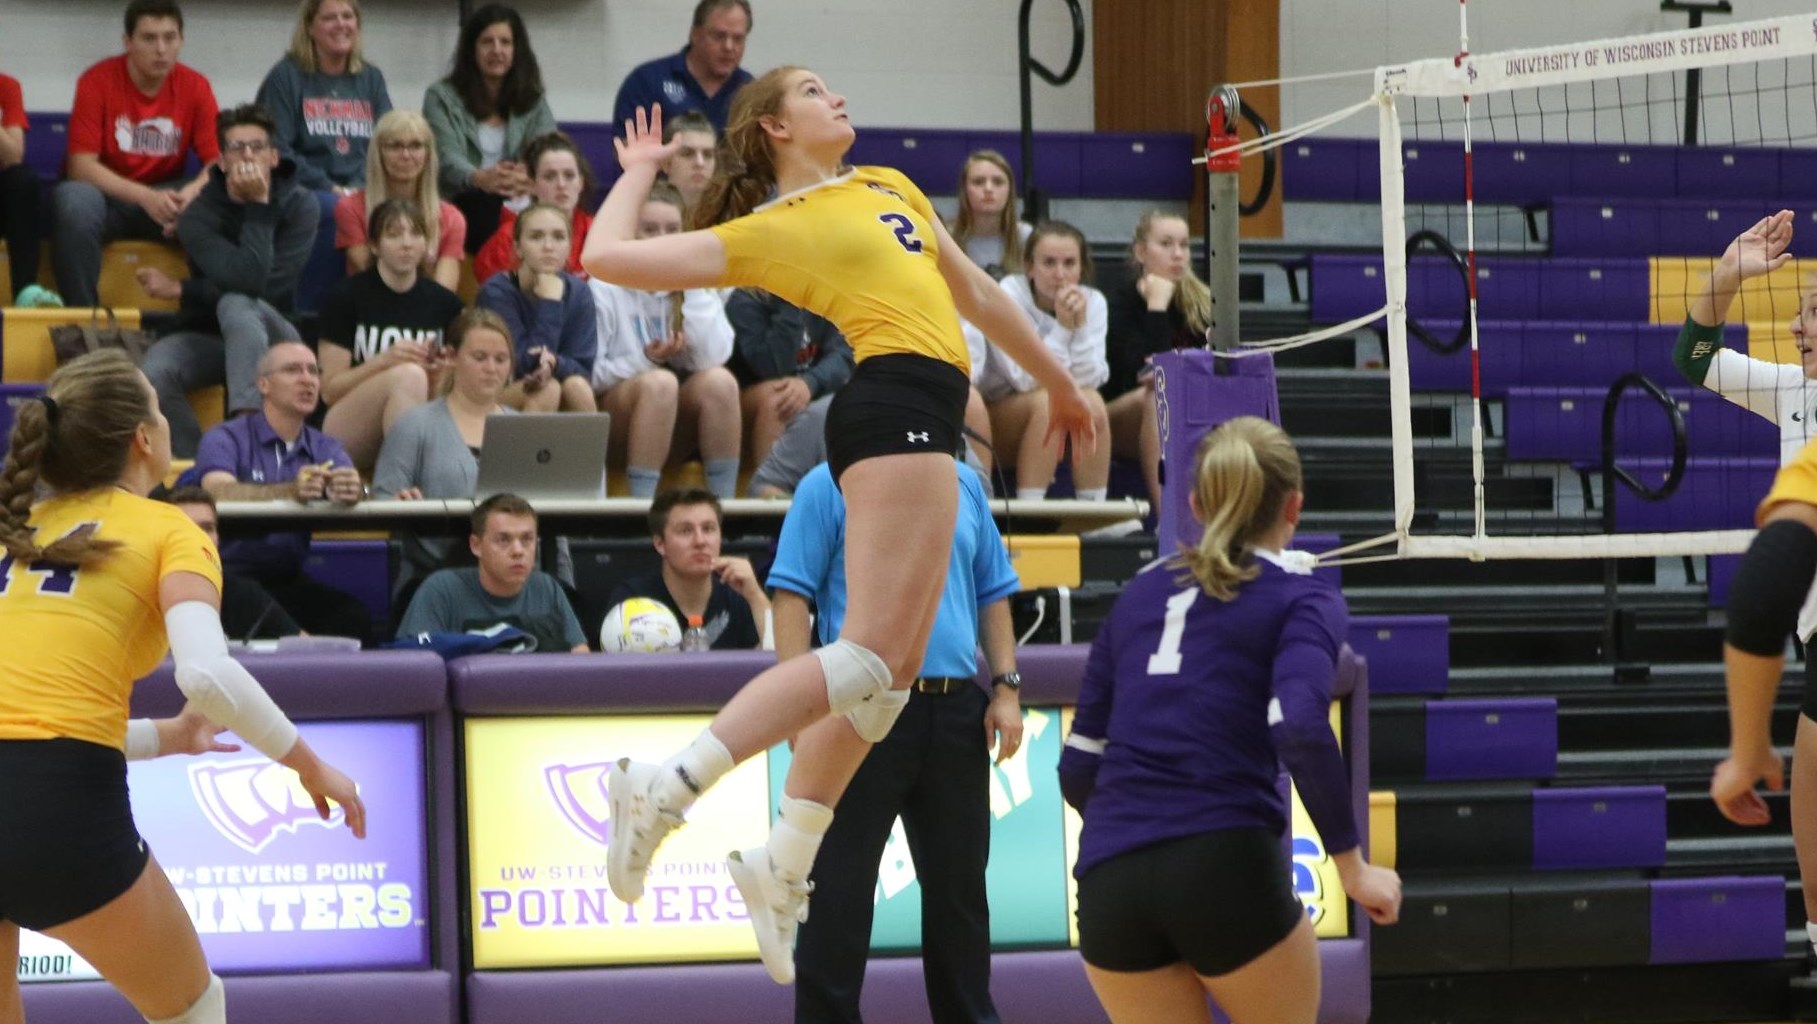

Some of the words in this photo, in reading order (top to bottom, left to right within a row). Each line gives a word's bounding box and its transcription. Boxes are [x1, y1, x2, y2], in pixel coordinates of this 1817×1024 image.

[1505, 51, 1580, 76] UNIVERSITY
[1584, 49, 1600, 67] OF
[1604, 40, 1676, 64] WISCONSIN
[1680, 32, 1738, 57] STEVENS
[1742, 27, 1781, 47] POINT
[305, 119, 374, 138] VOLLEYBALL
[879, 212, 922, 254] 2
[1146, 586, 1200, 675] 1
[163, 863, 309, 886] W-STEVENS
[316, 862, 388, 881] POINT
[500, 863, 654, 882] UW-STEVS
[664, 860, 728, 876] POINT
[176, 882, 413, 934] INTERS
[19, 955, 72, 974] RIOD!
